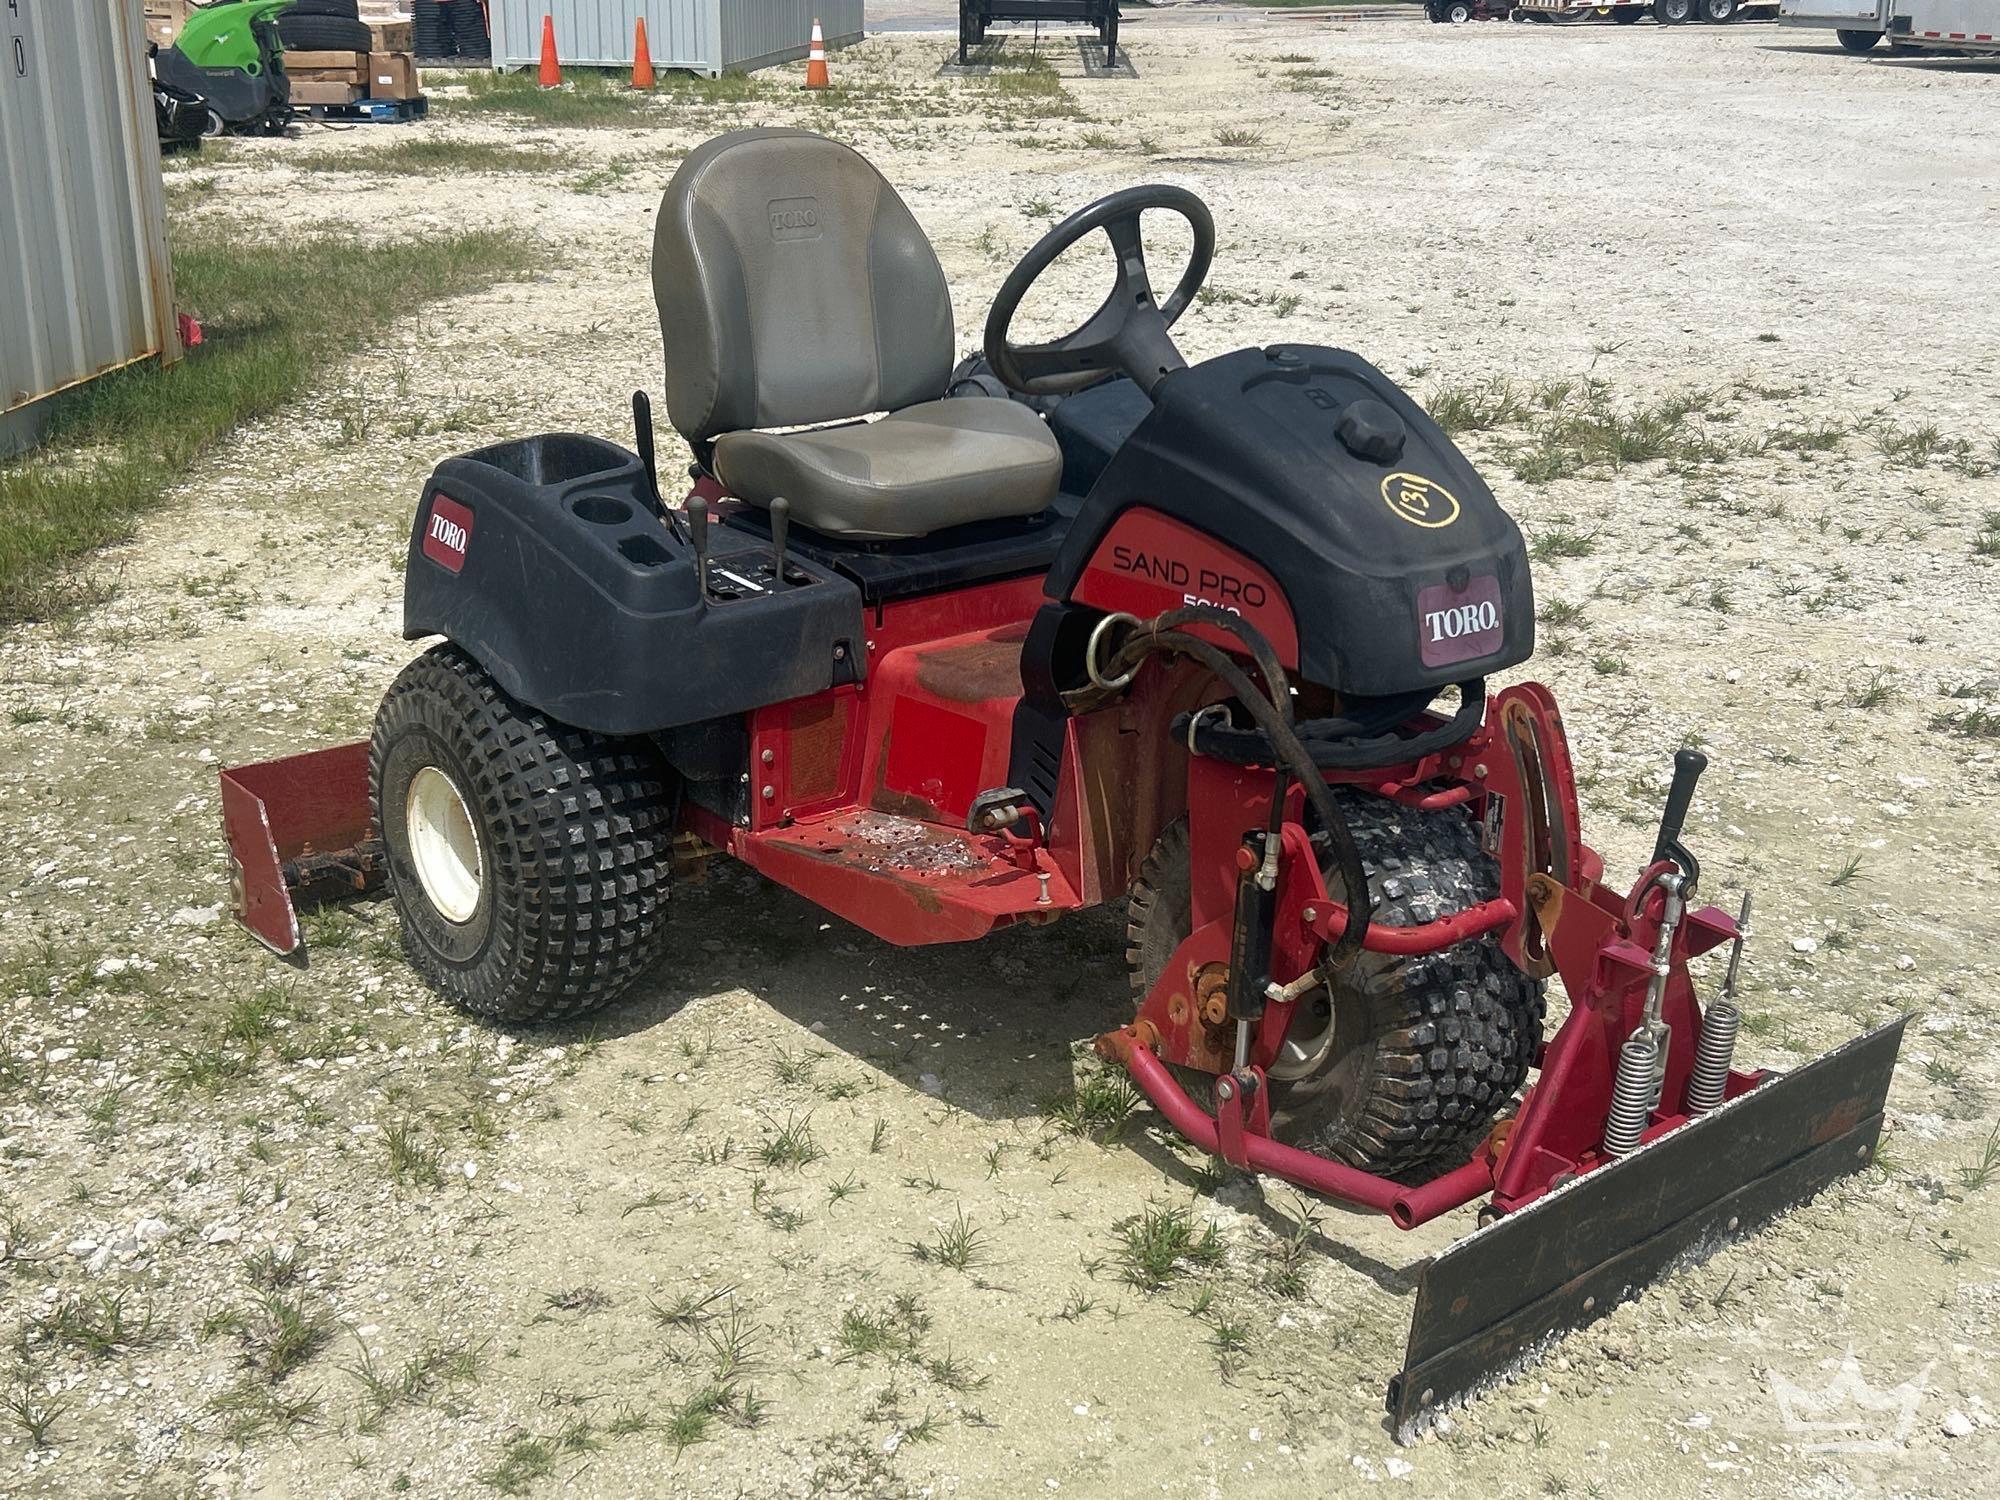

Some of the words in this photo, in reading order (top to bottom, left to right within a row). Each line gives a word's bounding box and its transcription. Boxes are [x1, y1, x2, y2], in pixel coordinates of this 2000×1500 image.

[771, 208, 818, 230] TORO
[430, 513, 467, 552] TORO
[1113, 546, 1189, 587] SAND
[1200, 570, 1267, 608] PRO
[1425, 601, 1498, 642] TORO
